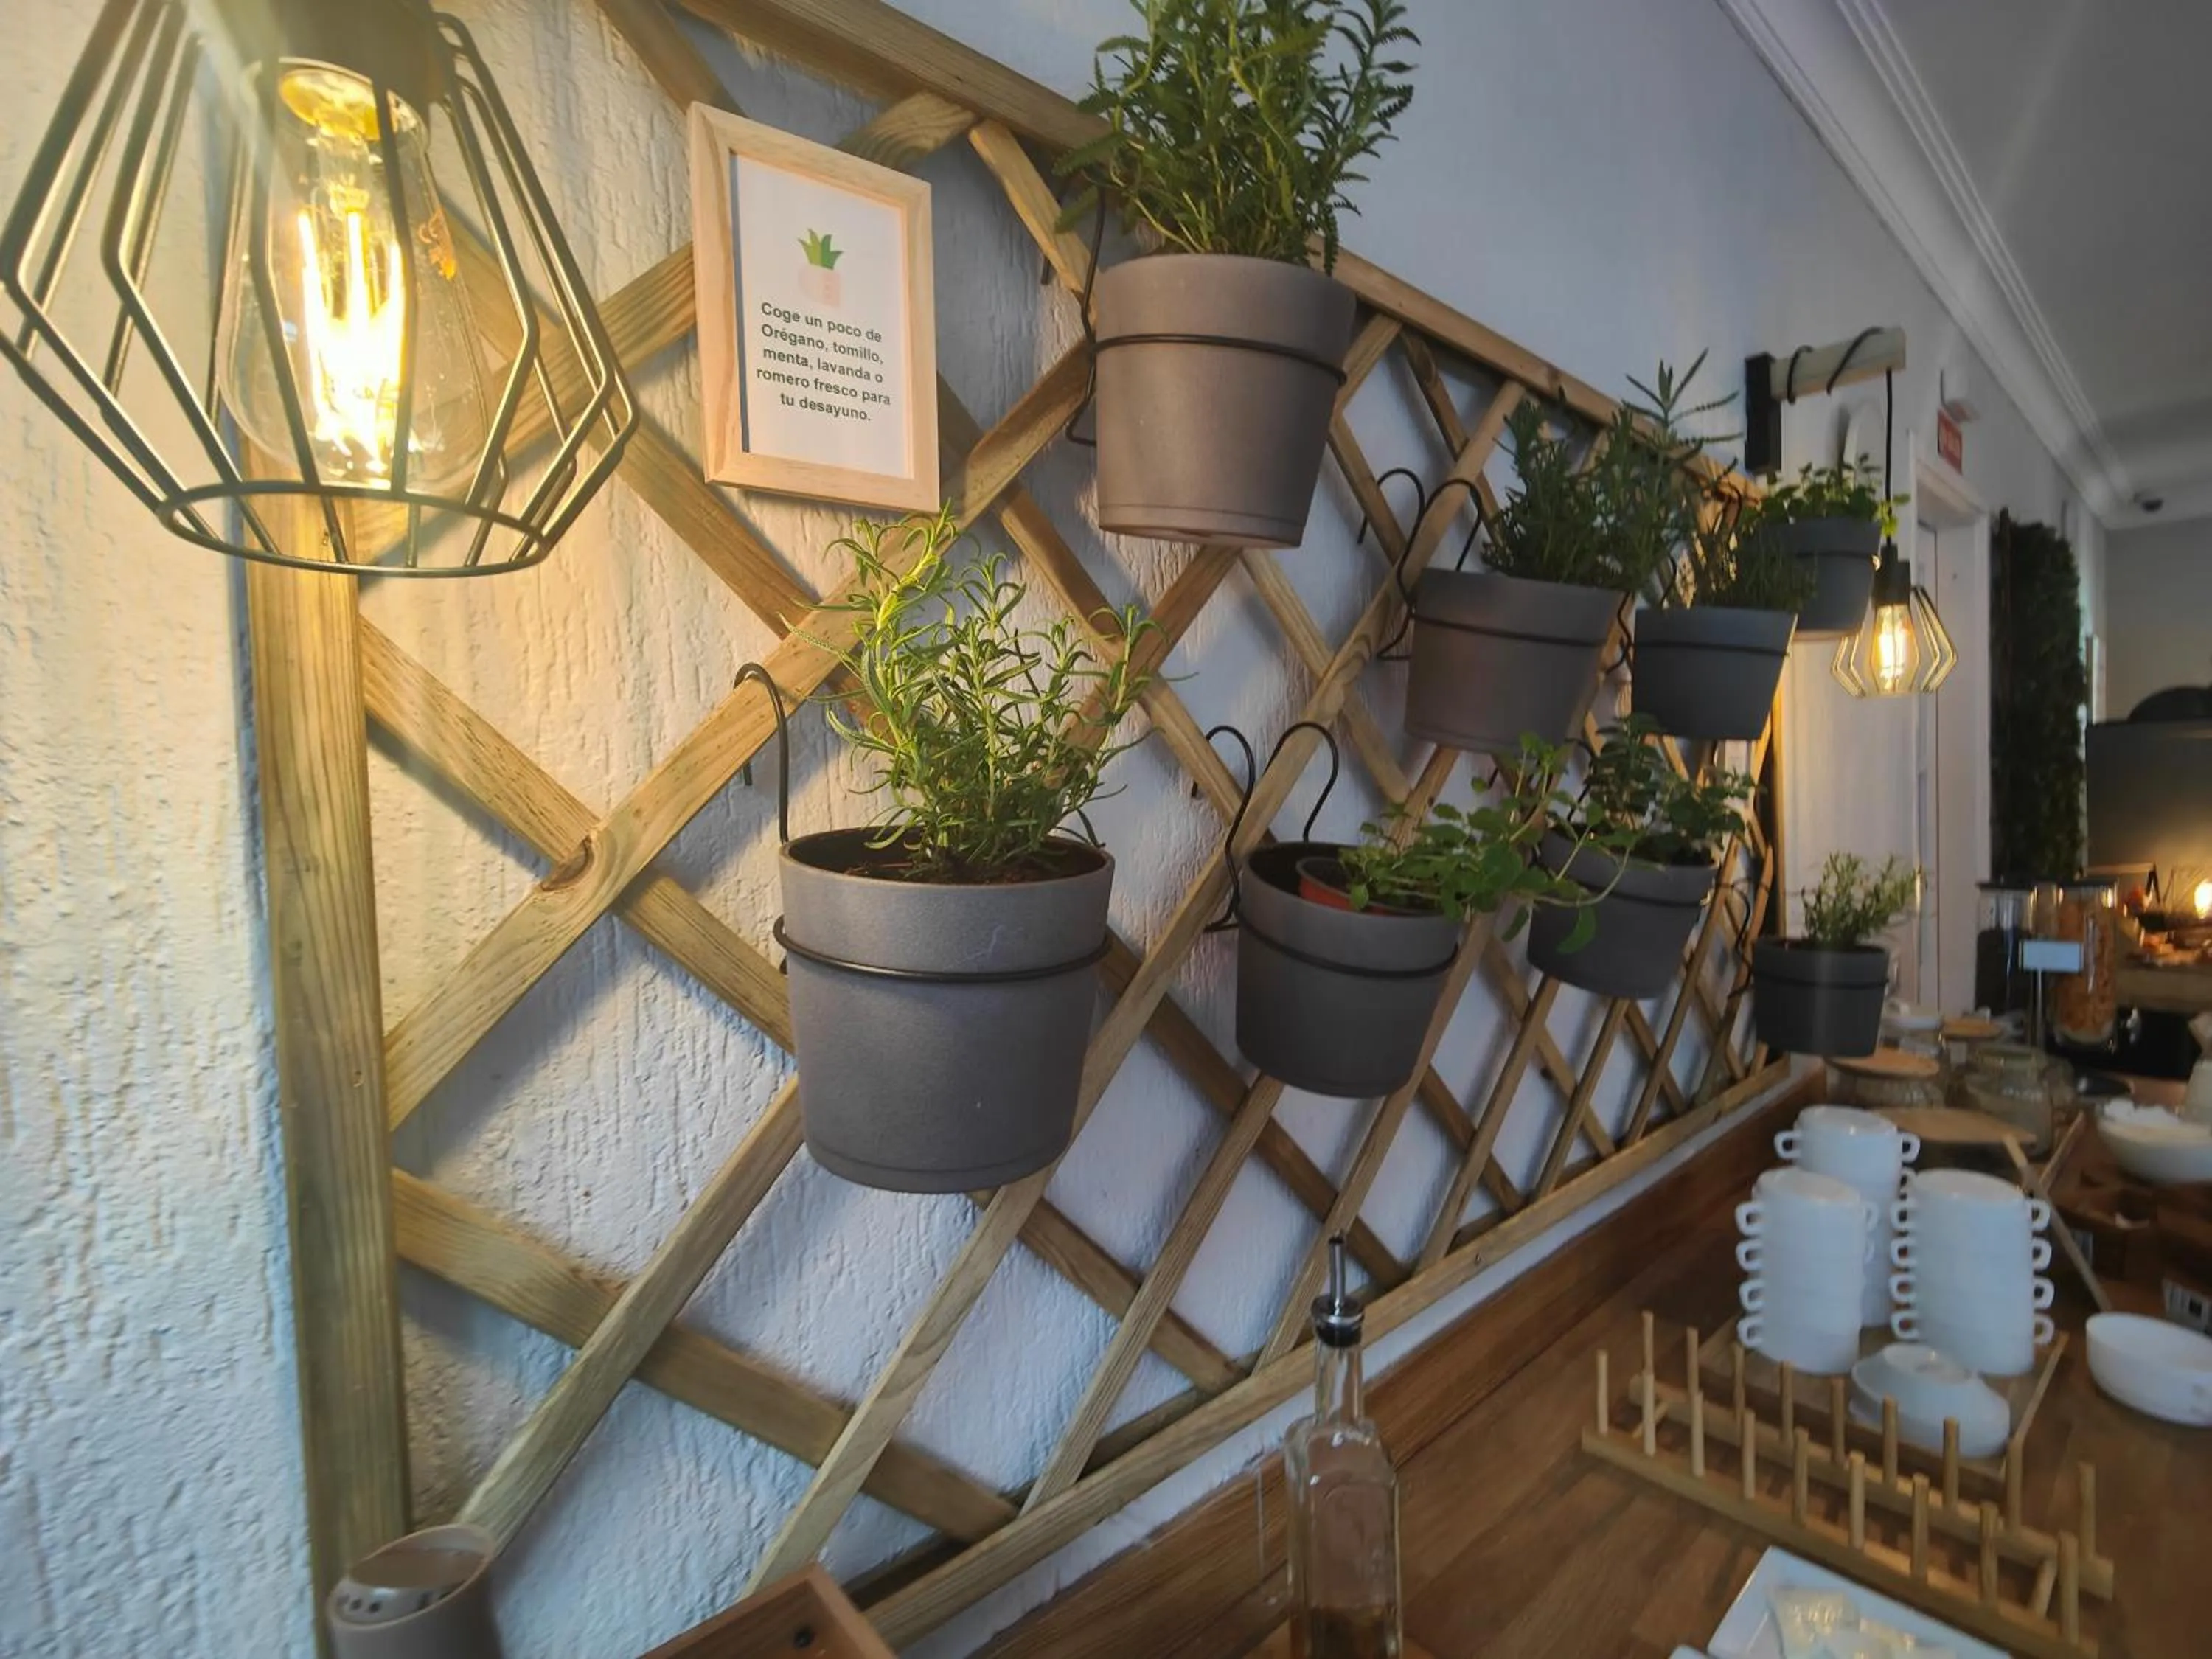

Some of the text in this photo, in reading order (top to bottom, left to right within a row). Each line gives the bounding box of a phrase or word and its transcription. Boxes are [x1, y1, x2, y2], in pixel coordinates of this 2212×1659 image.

[761, 302, 882, 343] Coge un poco de
[762, 324, 884, 364] Orégano, tomillo,
[763, 347, 883, 383] menta, lavanda o
[757, 368, 891, 405] romero fresco para
[780, 393, 872, 421] tu desayuno.
